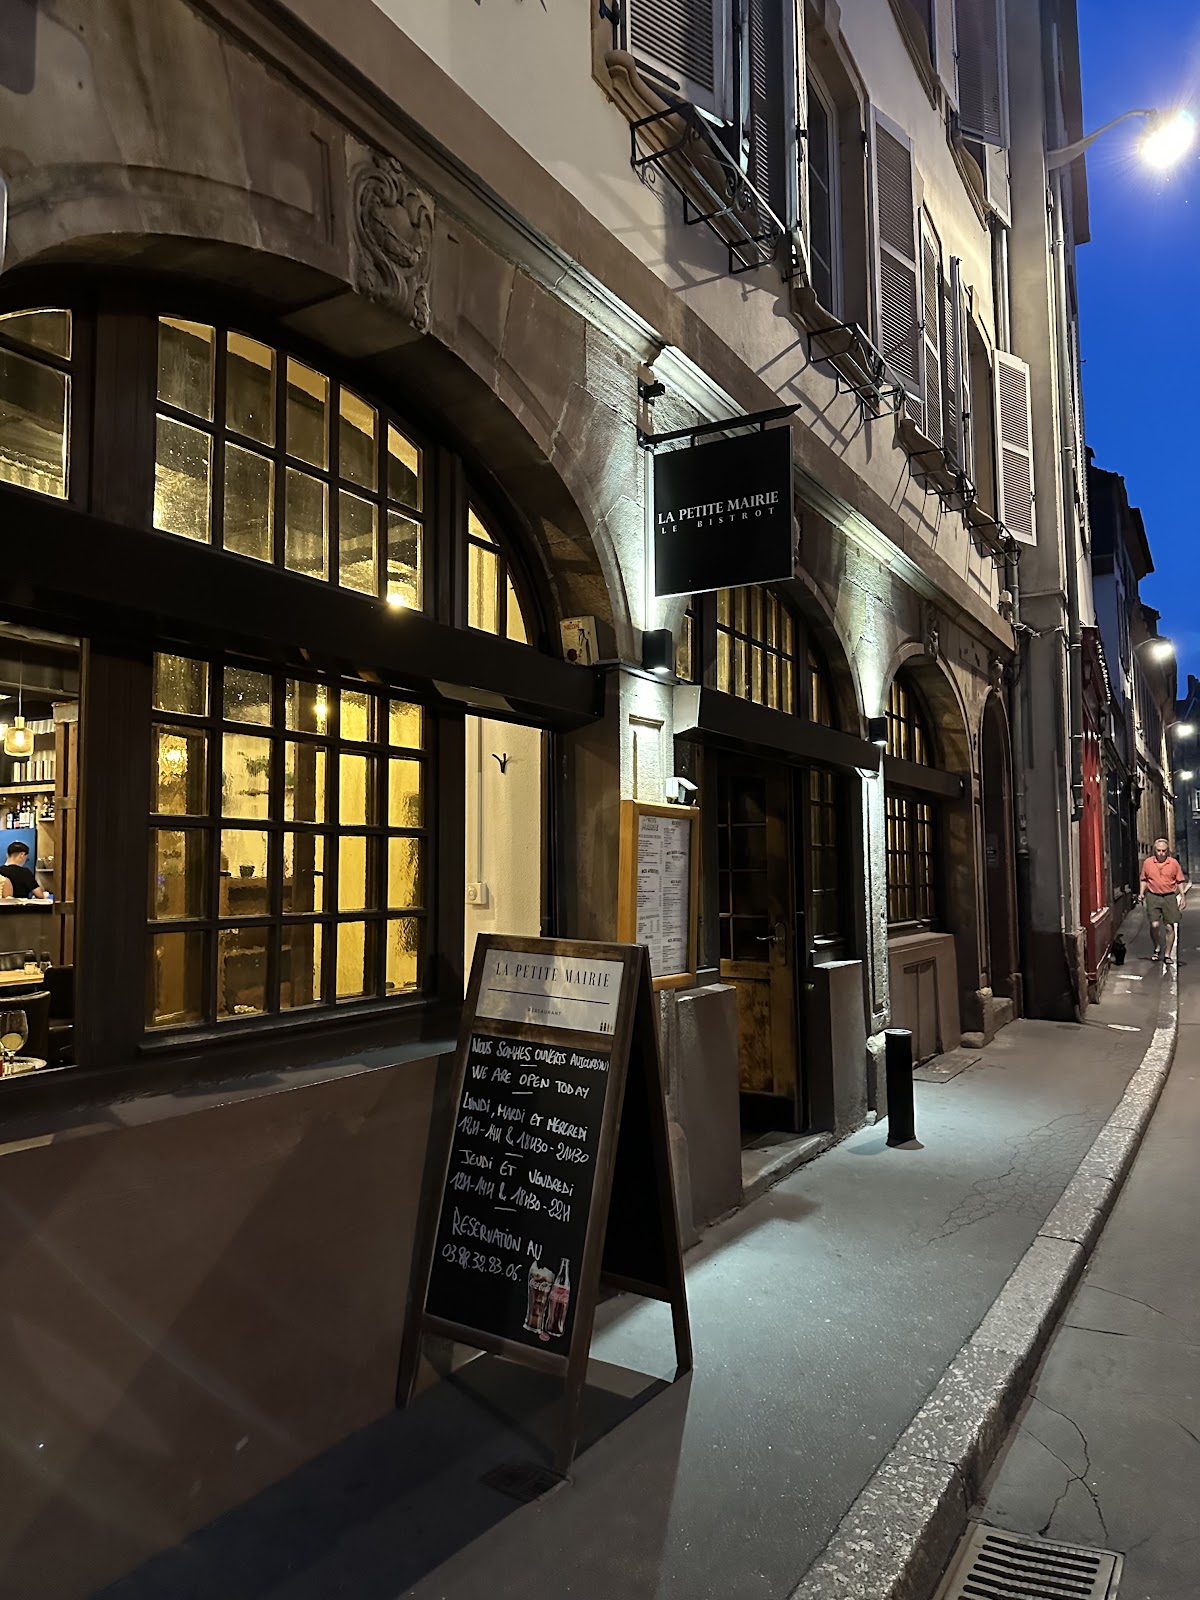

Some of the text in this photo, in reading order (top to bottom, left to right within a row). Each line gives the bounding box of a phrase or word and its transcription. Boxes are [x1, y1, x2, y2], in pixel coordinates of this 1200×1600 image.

[658, 490, 779, 525] LA PETITE MAIRIE
[661, 507, 775, 535] LE BISTROT
[495, 961, 611, 988] LA PETITE MAIRIE
[527, 1007, 562, 1016] RESTAURANT
[496, 1040, 532, 1062] SOMMES
[534, 1048, 567, 1066] OUVERTS
[472, 1064, 590, 1099] WE ARE OPEN TODAY
[529, 1112, 545, 1127] ET
[505, 1126, 515, 1147] &
[499, 1161, 517, 1176] ET
[526, 1239, 543, 1261] AU
